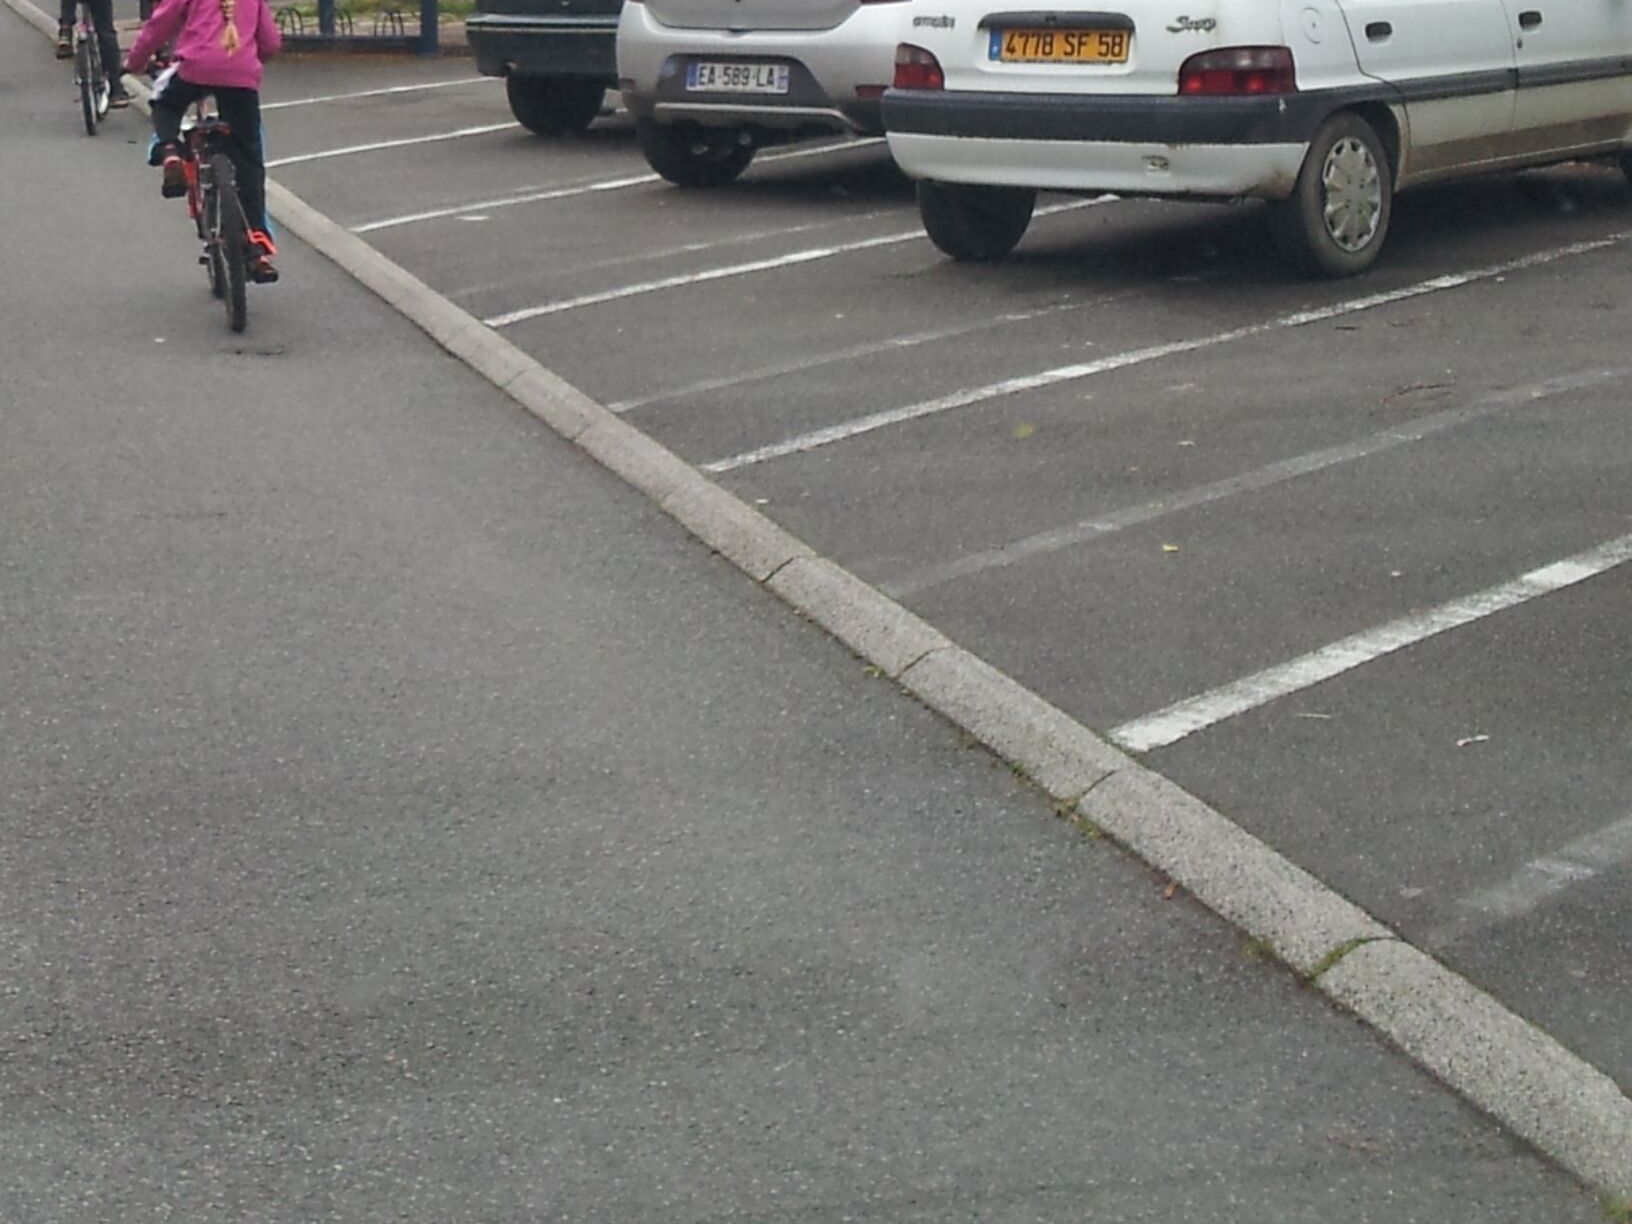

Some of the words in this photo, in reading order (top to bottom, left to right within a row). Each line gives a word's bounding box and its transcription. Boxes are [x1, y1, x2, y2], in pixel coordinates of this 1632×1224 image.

[1006, 33, 1054, 57] 4778
[1062, 33, 1091, 57] SF
[1097, 33, 1124, 58] 58
